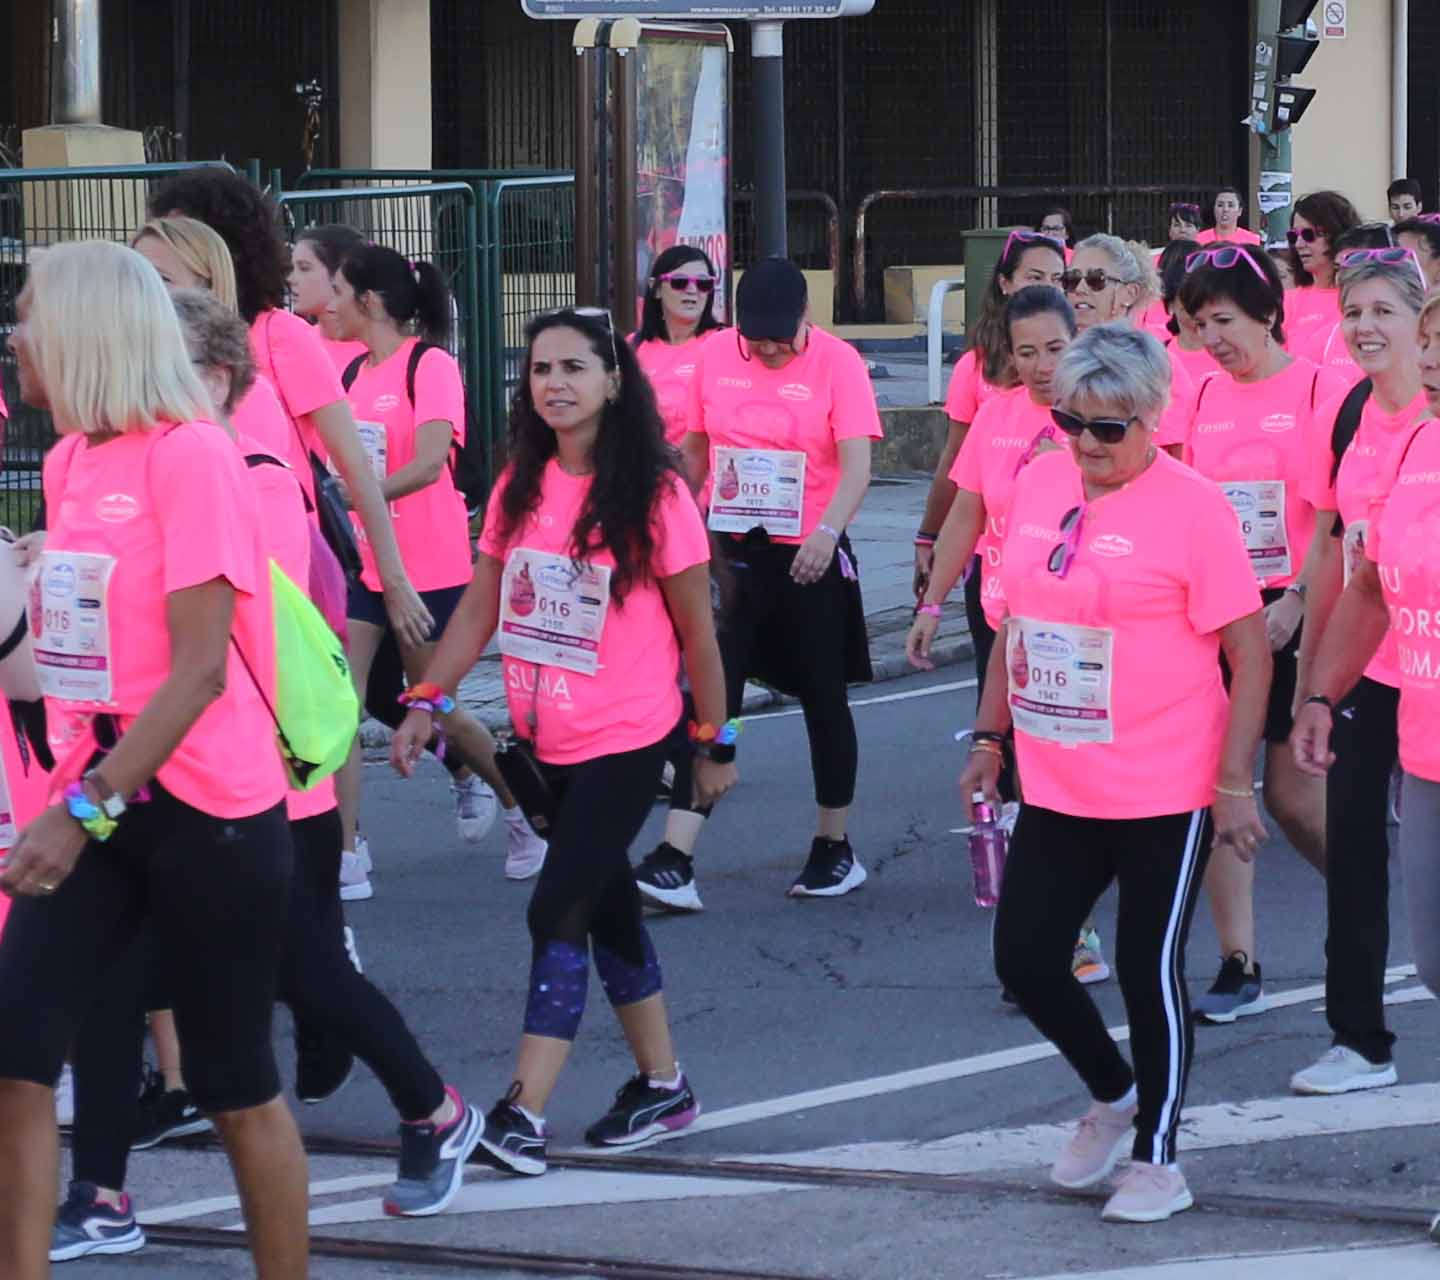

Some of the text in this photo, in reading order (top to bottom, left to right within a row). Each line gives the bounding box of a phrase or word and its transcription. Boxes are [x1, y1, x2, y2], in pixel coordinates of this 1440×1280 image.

[741, 481, 771, 496] 016
[538, 596, 571, 618] 016
[509, 662, 572, 701] SUMA
[1032, 666, 1067, 688] 016
